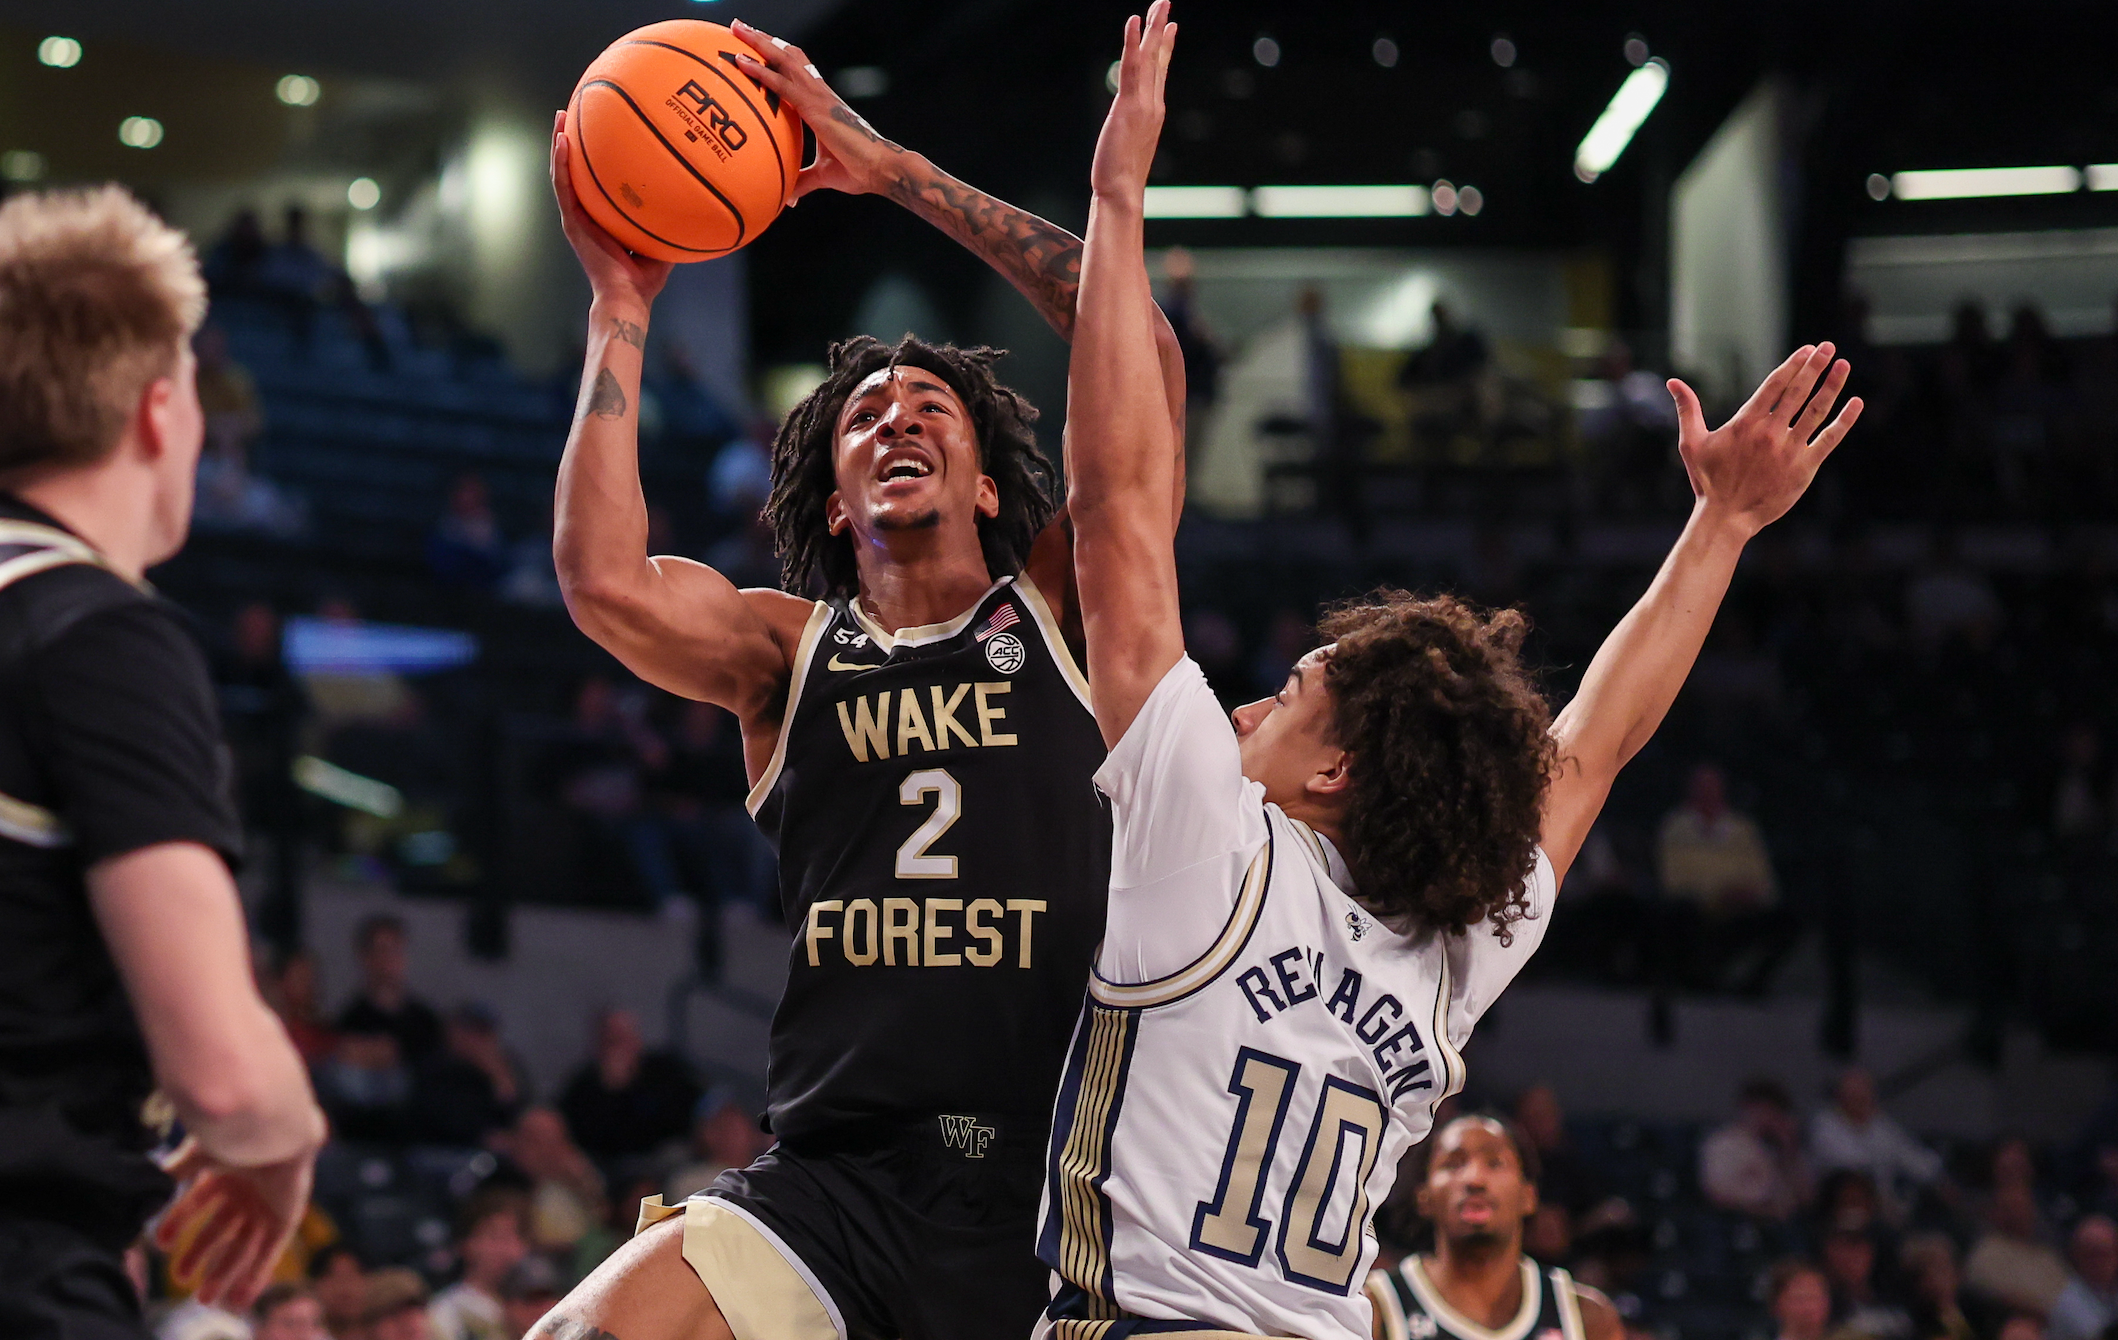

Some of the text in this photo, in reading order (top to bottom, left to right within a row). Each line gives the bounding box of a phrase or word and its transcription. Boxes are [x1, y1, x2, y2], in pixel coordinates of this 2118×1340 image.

[665, 98, 728, 163] OFFICIAL GAME BALL
[676, 79, 747, 151] PRO
[833, 627, 870, 649] 54
[836, 681, 1018, 763] WAKE
[894, 768, 962, 880] 2
[805, 898, 1047, 969] FOREST
[938, 1114, 995, 1159] WF
[1189, 1045, 1389, 1298] 10
